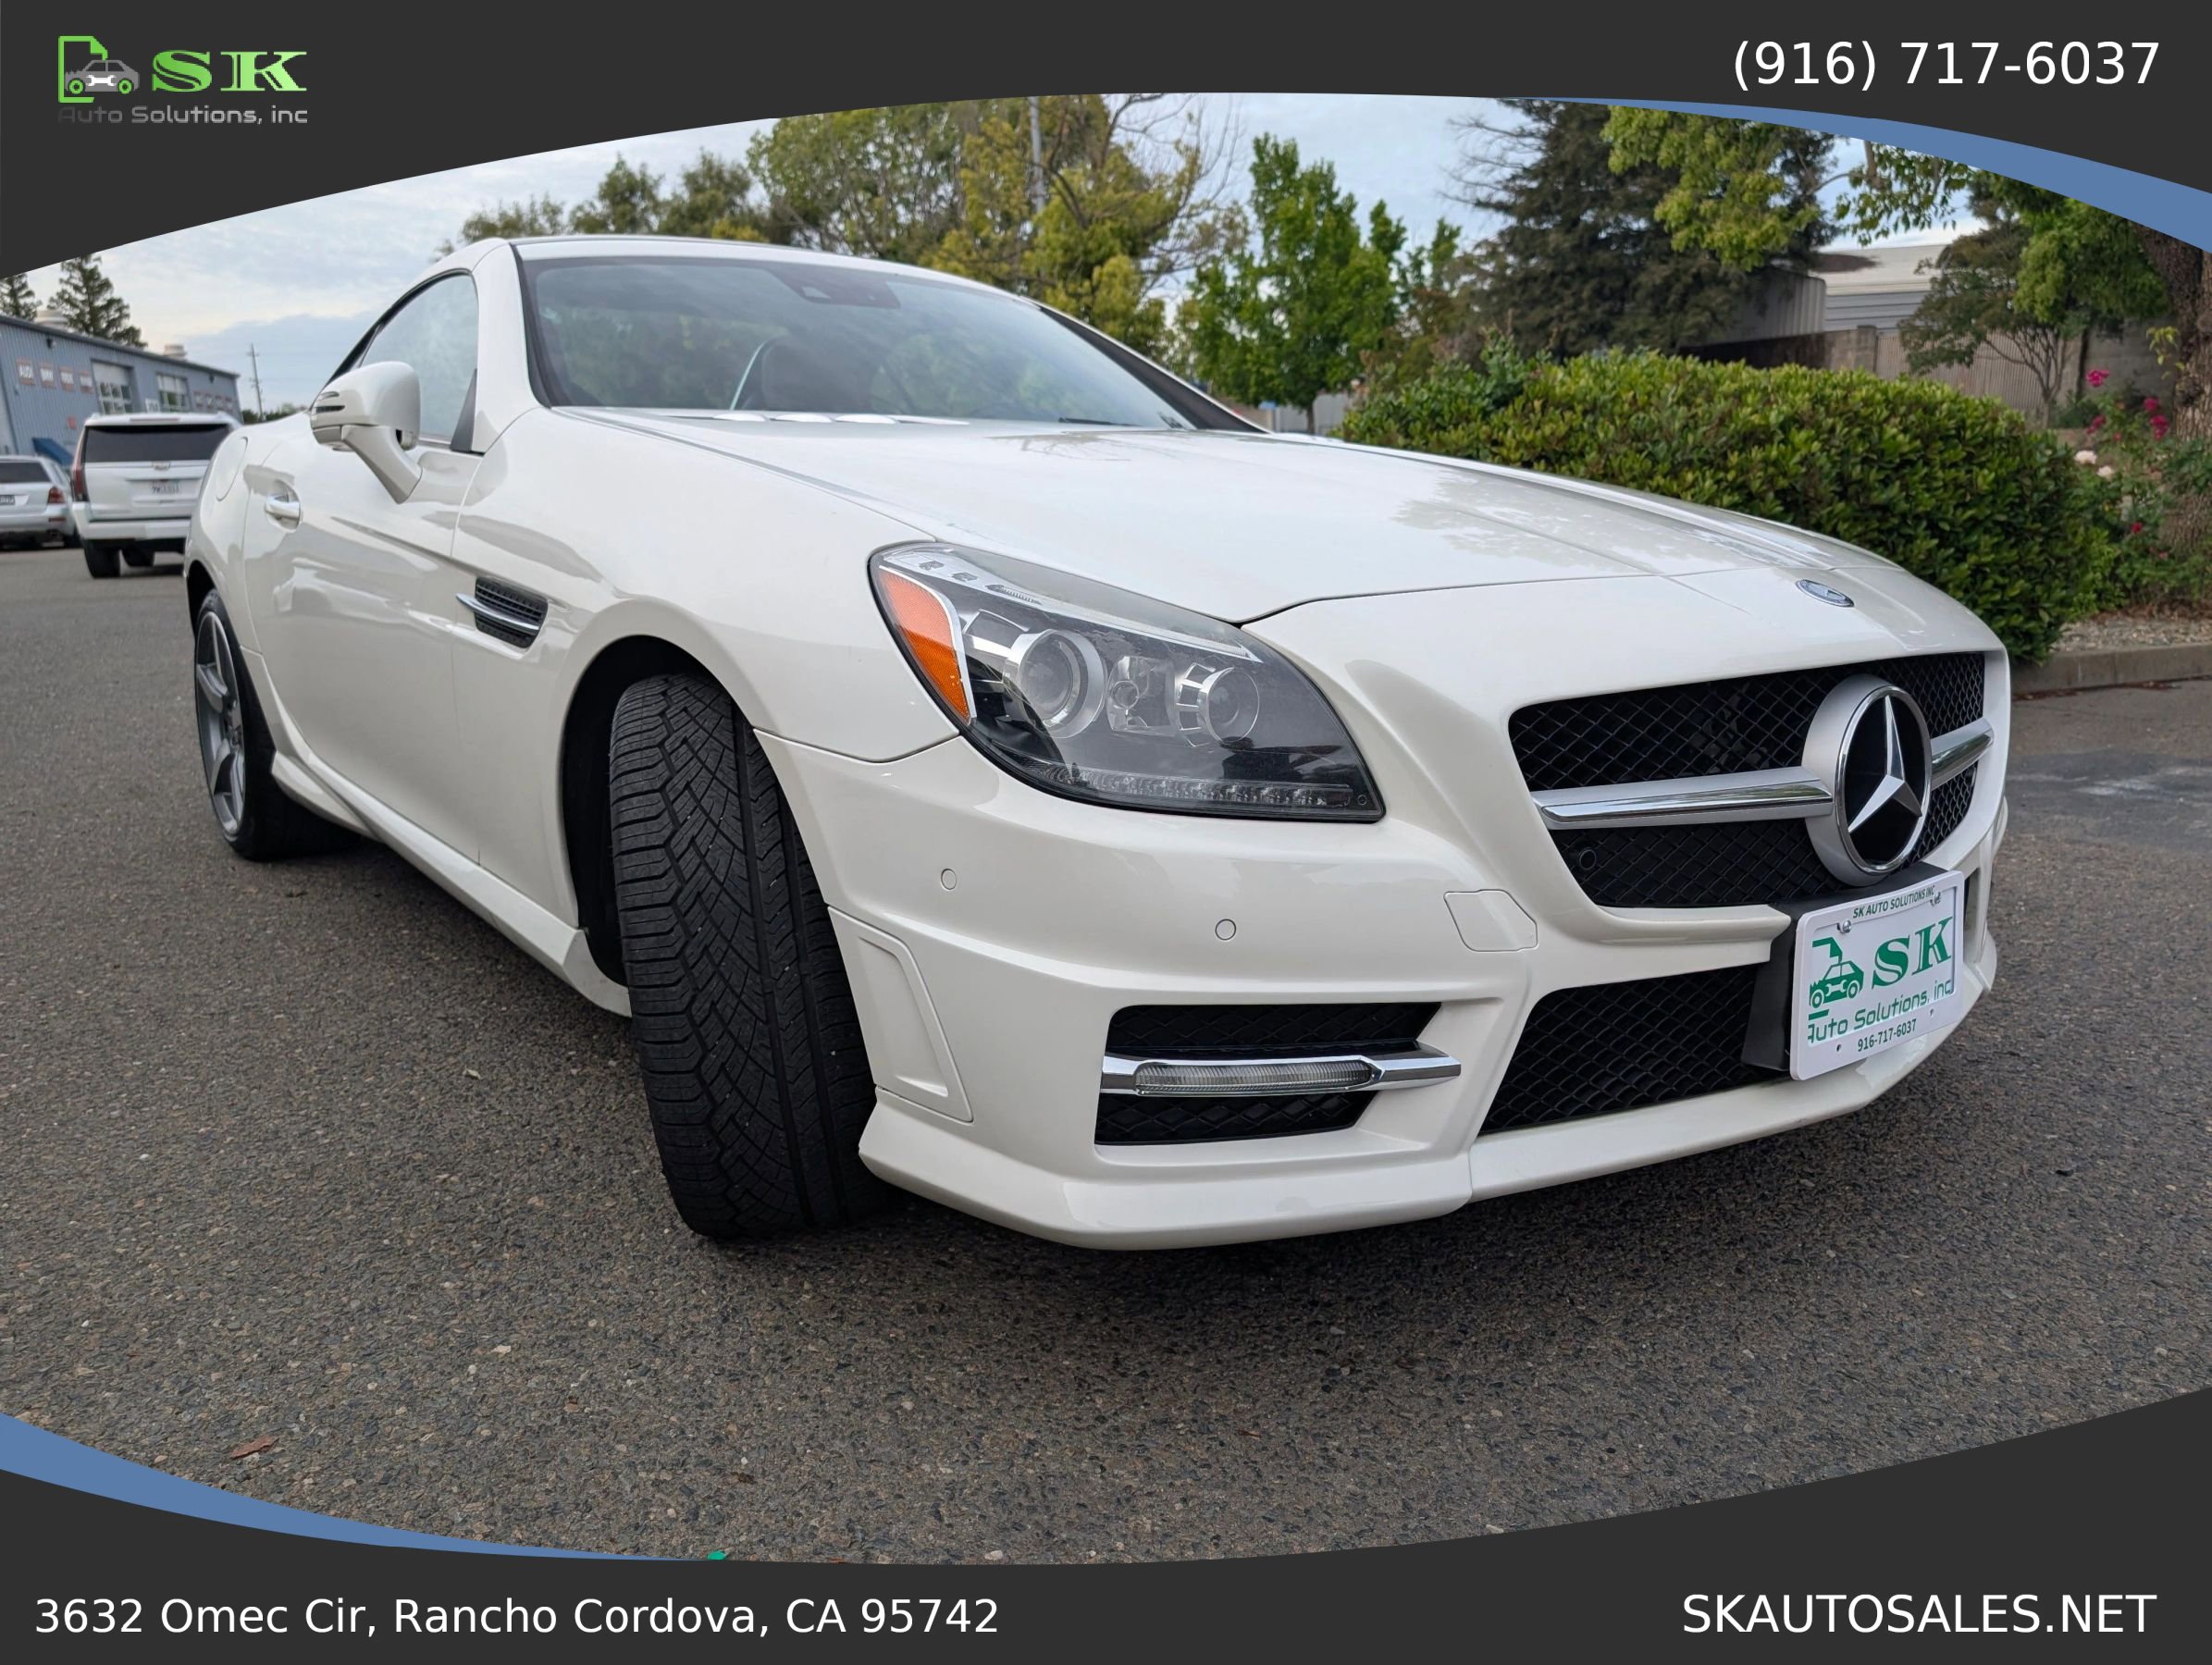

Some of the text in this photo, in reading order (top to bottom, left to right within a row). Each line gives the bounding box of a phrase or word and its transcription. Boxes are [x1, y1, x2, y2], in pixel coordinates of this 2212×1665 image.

[1853, 885, 1935, 919] SK AUTO SOLUTIONS INC
[1872, 917, 1953, 990] SK
[1934, 980, 1952, 1000] inc
[1858, 1018, 1917, 1052] 916-717-6037
